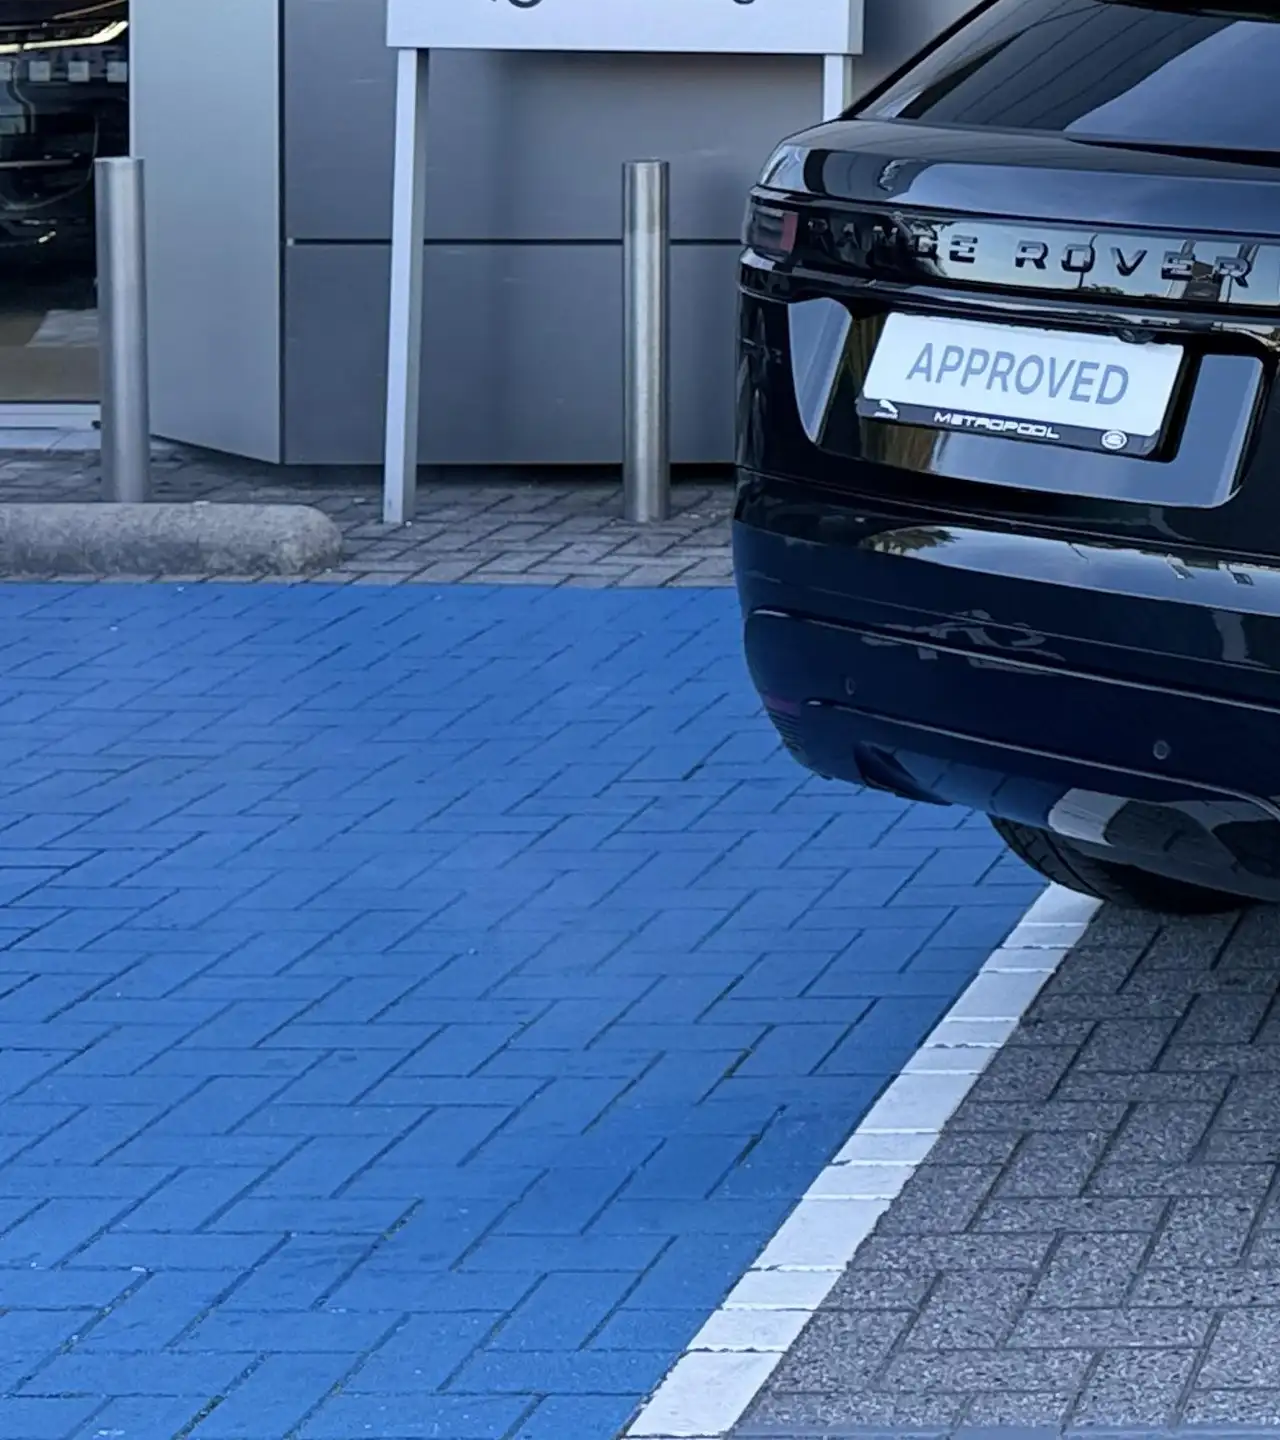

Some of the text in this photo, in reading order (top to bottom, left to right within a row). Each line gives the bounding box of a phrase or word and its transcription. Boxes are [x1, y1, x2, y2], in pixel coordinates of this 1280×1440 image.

[1014, 239, 1252, 288] ROVER
[906, 341, 1130, 407] APPROVED
[934, 411, 1060, 439] METROPOOL
